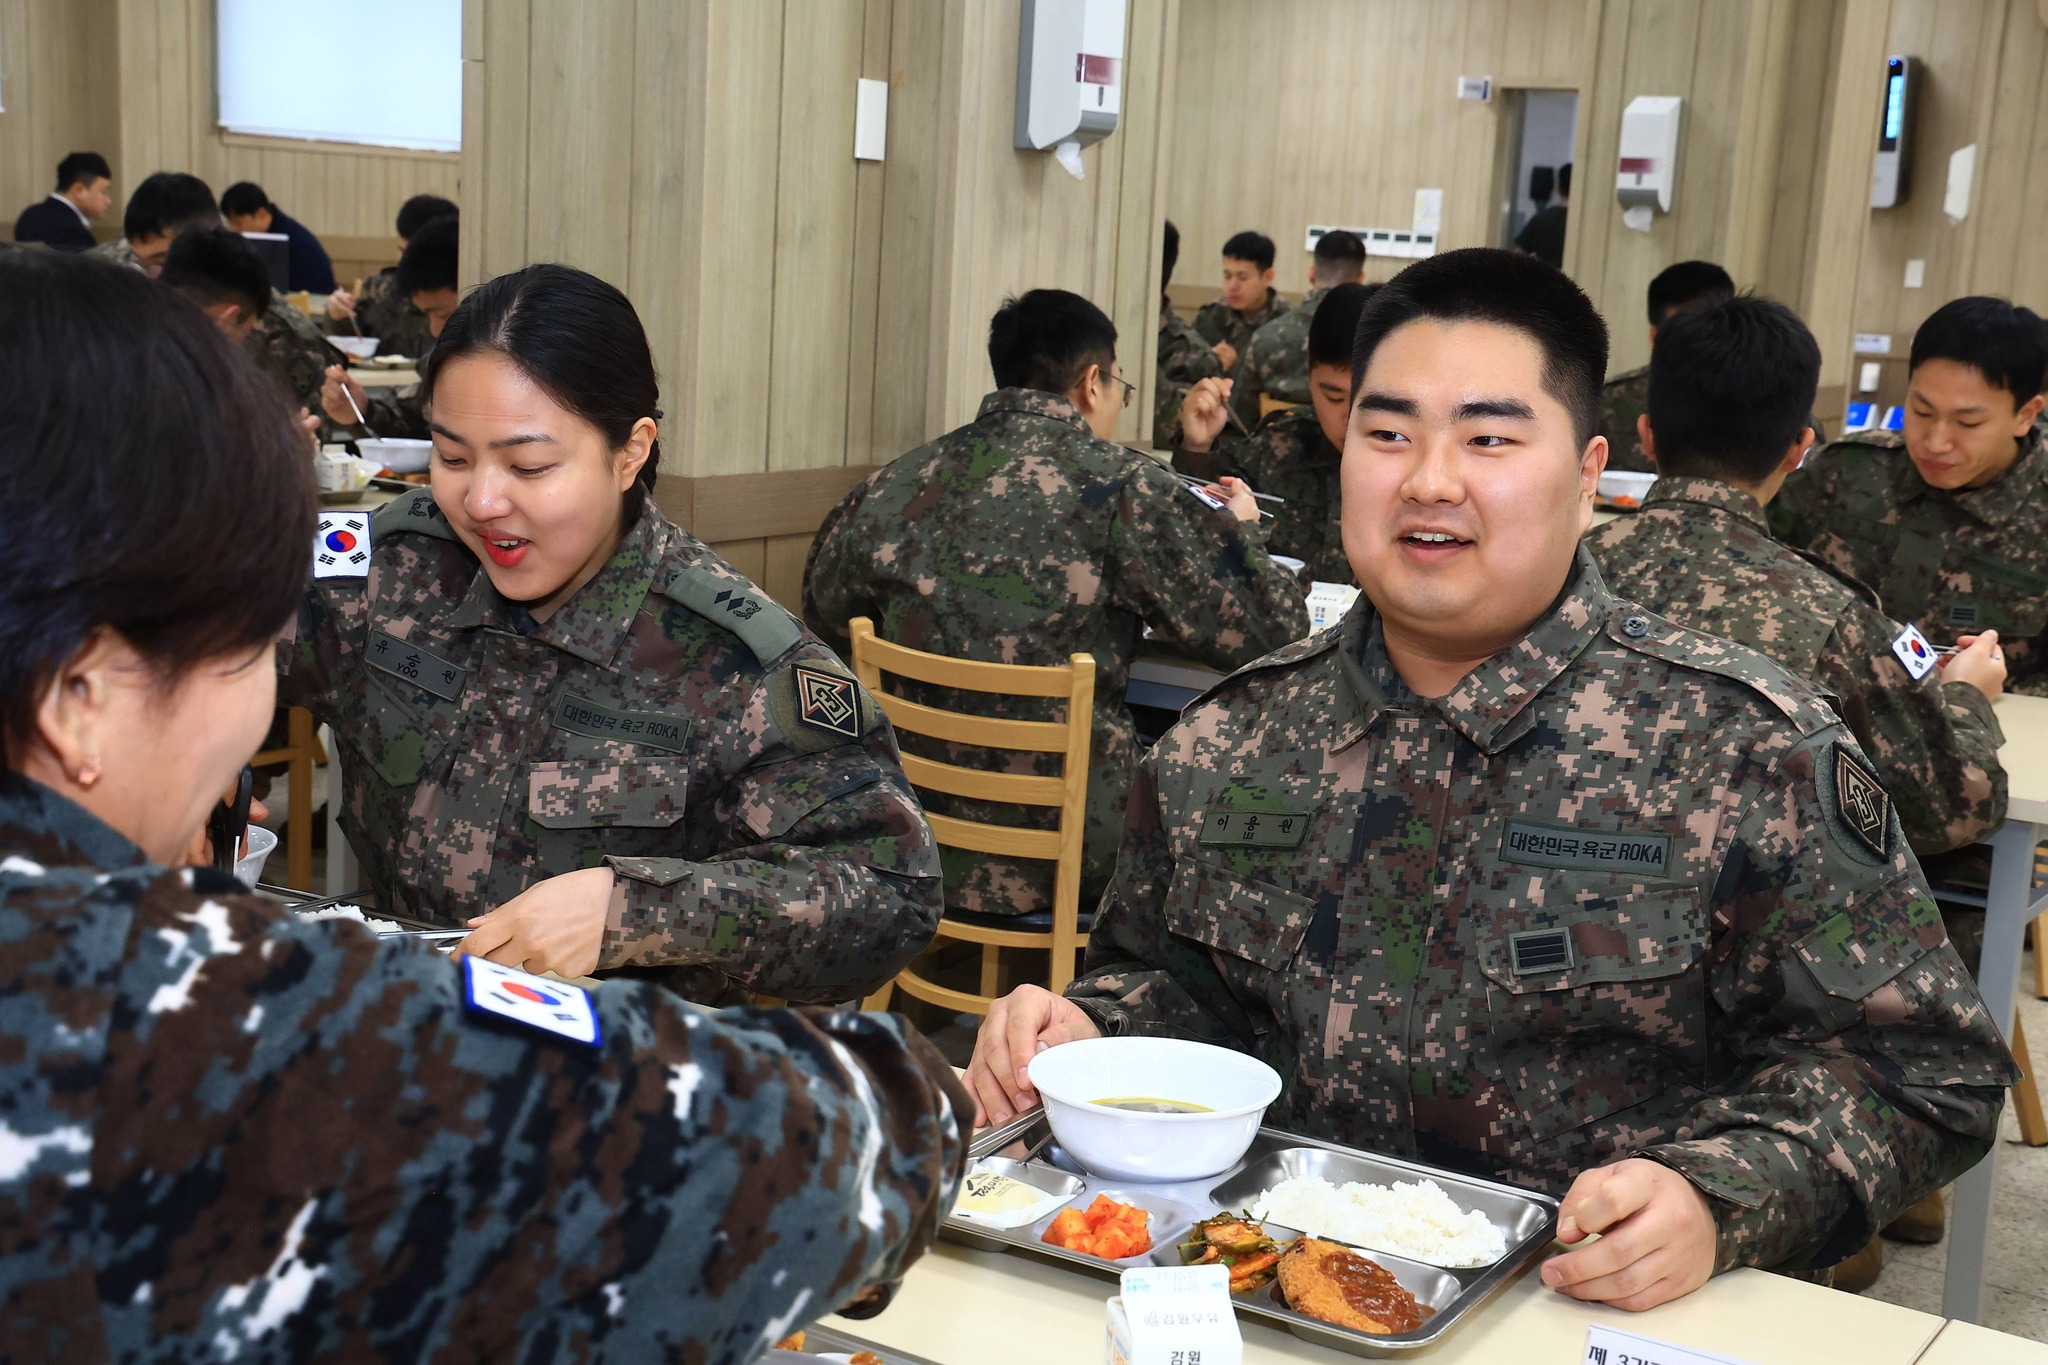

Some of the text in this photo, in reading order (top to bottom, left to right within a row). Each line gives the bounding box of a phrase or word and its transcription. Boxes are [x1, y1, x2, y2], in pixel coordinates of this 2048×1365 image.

[375, 640, 457, 685] 유 승 원
[396, 662, 419, 678] YOO
[815, 687, 842, 713] 3
[563, 704, 679, 740] 대한민국 육군 ROKA
[1852, 783, 1872, 820] 3
[1217, 814, 1229, 831] 이
[1278, 818, 1293, 833] 원
[1242, 831, 1256, 840] LEE
[1509, 831, 1662, 865] 대한민국 육군 ROKA
